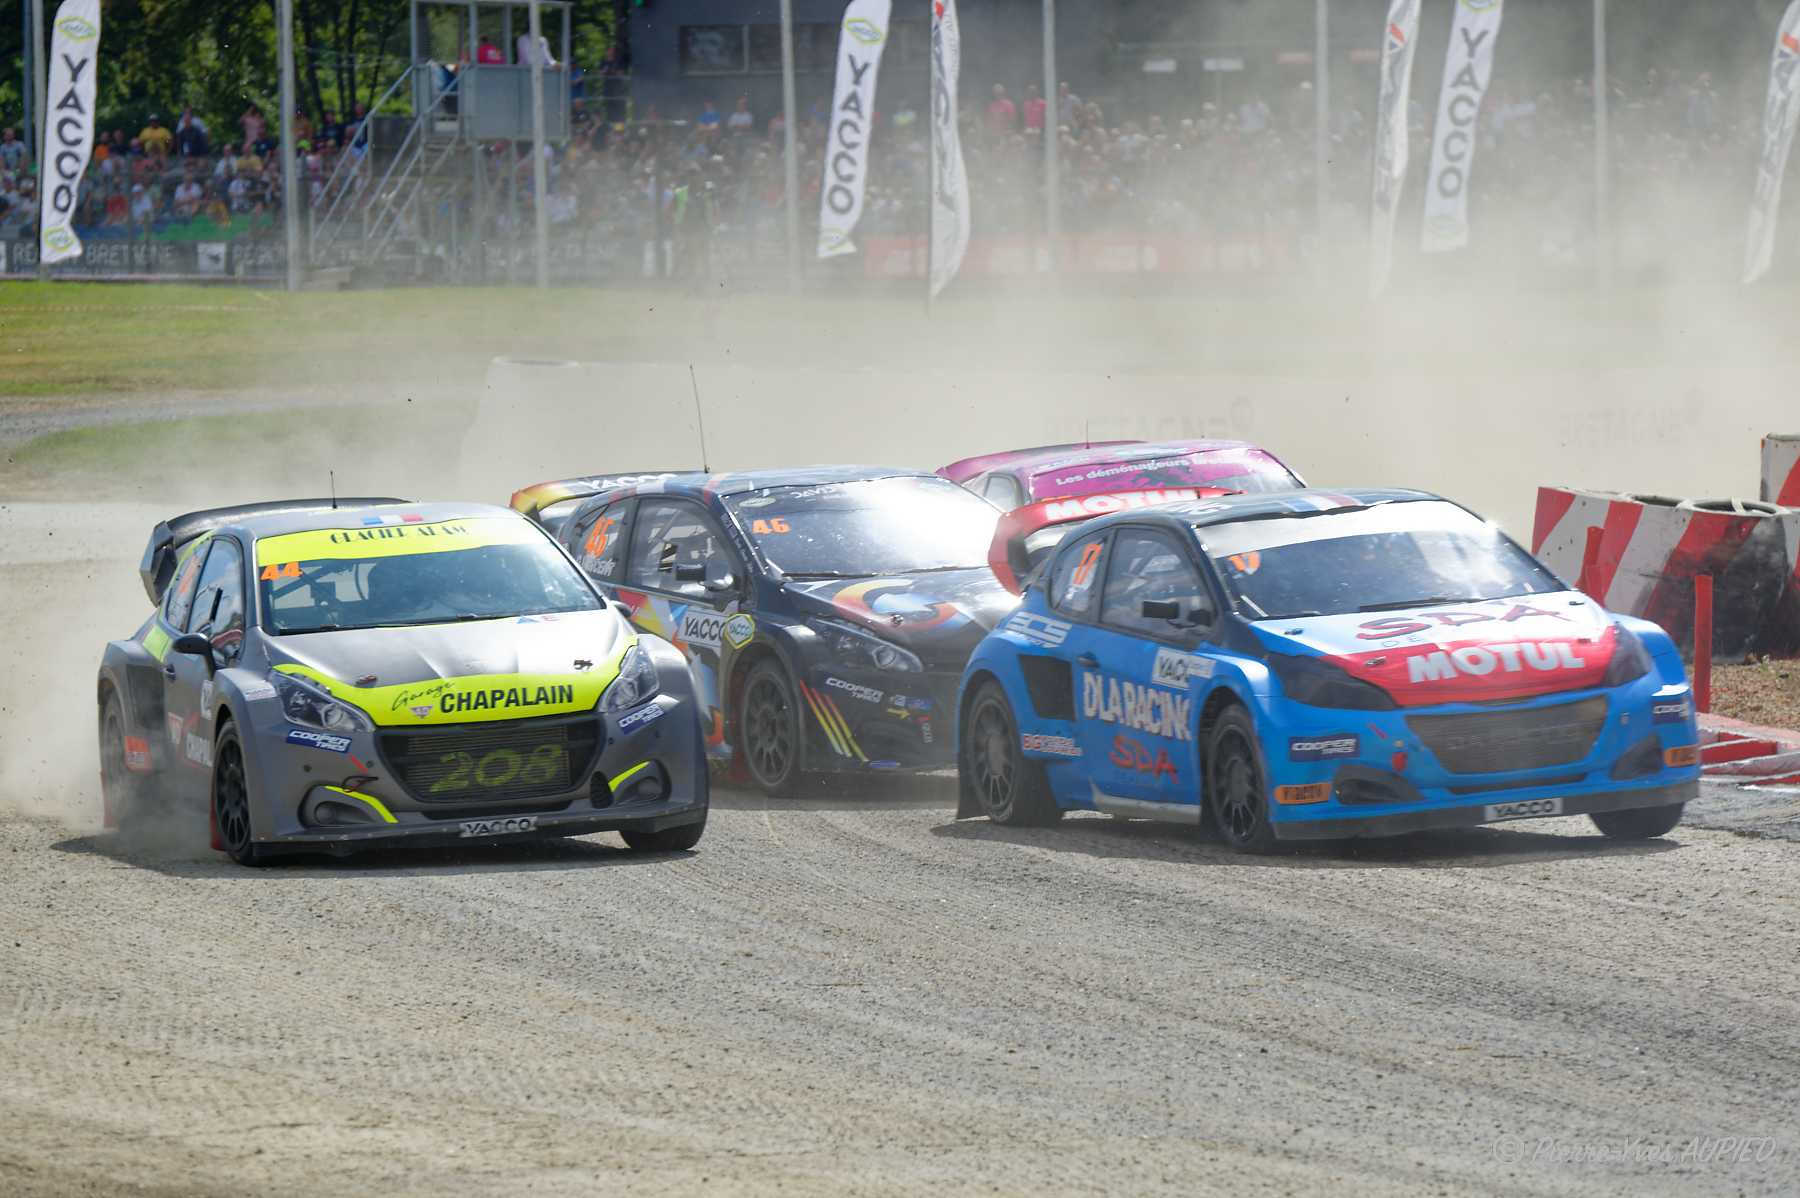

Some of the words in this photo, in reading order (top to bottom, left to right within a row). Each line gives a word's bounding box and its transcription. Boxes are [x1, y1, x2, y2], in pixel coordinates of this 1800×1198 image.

[1437, 27, 1489, 199] YACCO
[53, 54, 89, 213] YACCO
[827, 54, 871, 215] YACCO
[752, 515, 789, 535] 46
[260, 561, 304, 581] 44
[1356, 604, 1576, 640] SDA
[1407, 642, 1586, 684] MOTUL
[391, 680, 456, 711] Garage
[440, 684, 574, 713] CHAPALAIN
[826, 677, 884, 697] COOPER
[618, 703, 659, 728] COOPER
[289, 730, 352, 747] COOPER
[1109, 733, 1180, 785] SDA
[1492, 800, 1554, 816] YACCO
[466, 817, 532, 836] YACCO
